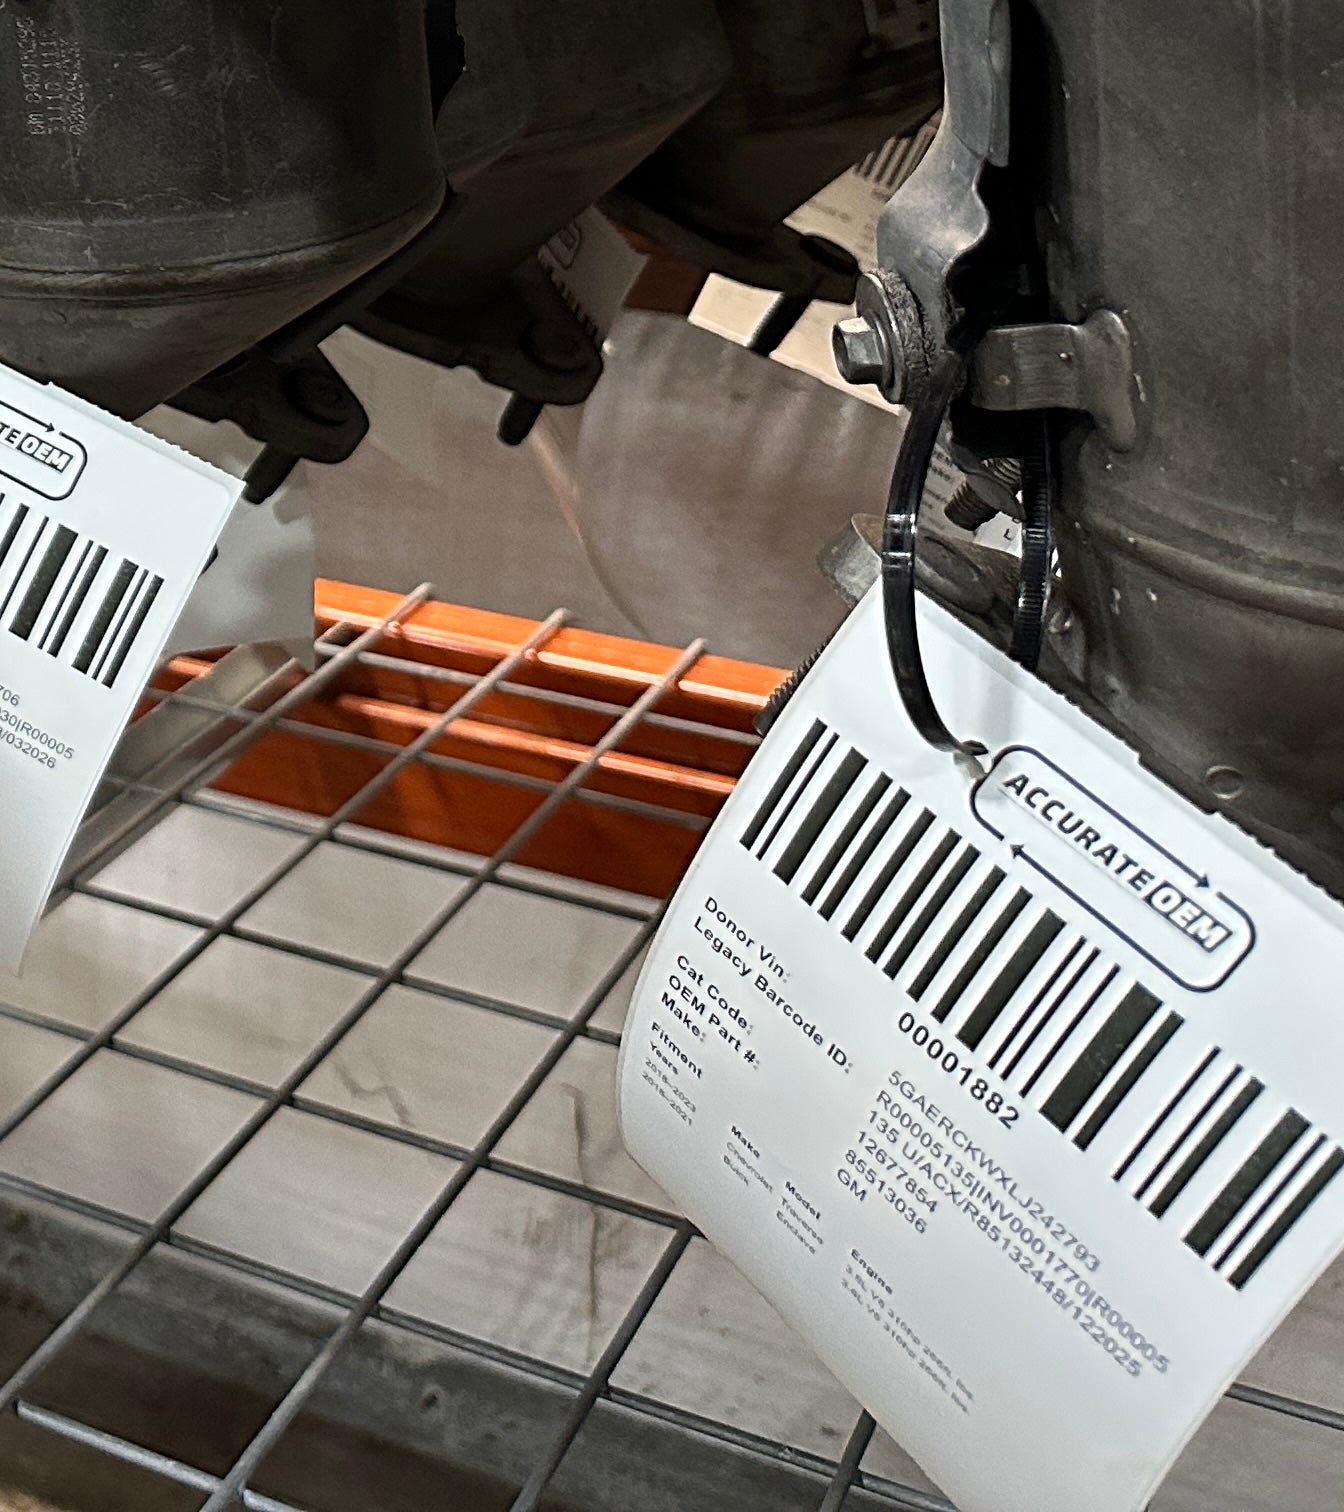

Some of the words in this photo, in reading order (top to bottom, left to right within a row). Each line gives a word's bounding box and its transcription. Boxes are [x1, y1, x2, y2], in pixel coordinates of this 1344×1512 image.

[702, 896, 757, 949] Donor
[754, 945, 793, 984] Vin:
[658, 991, 708, 1043] Make:
[666, 974, 707, 1016] OEM
[706, 1012, 744, 1052] Part
[673, 954, 706, 986] Cat
[704, 983, 755, 1035] Code:
[689, 916, 755, 978] Legacy
[752, 974, 826, 1046] Barcode
[826, 1040, 853, 1075] ID:
[648, 1021, 704, 1079] Fitment
[898, 1011, 1020, 1130] 00001882
[646, 1040, 681, 1075] Years
[729, 1125, 762, 1158] Make
[782, 1180, 822, 1220] Model
[848, 1248, 896, 1295] Engine
[864, 1108, 900, 1145] 135
[834, 1166, 868, 1201] GM
[843, 1147, 929, 1234] 85513036
[853, 1128, 939, 1214] 12677854
[886, 1068, 1101, 1273] 5GAERCKWXLJ242793
